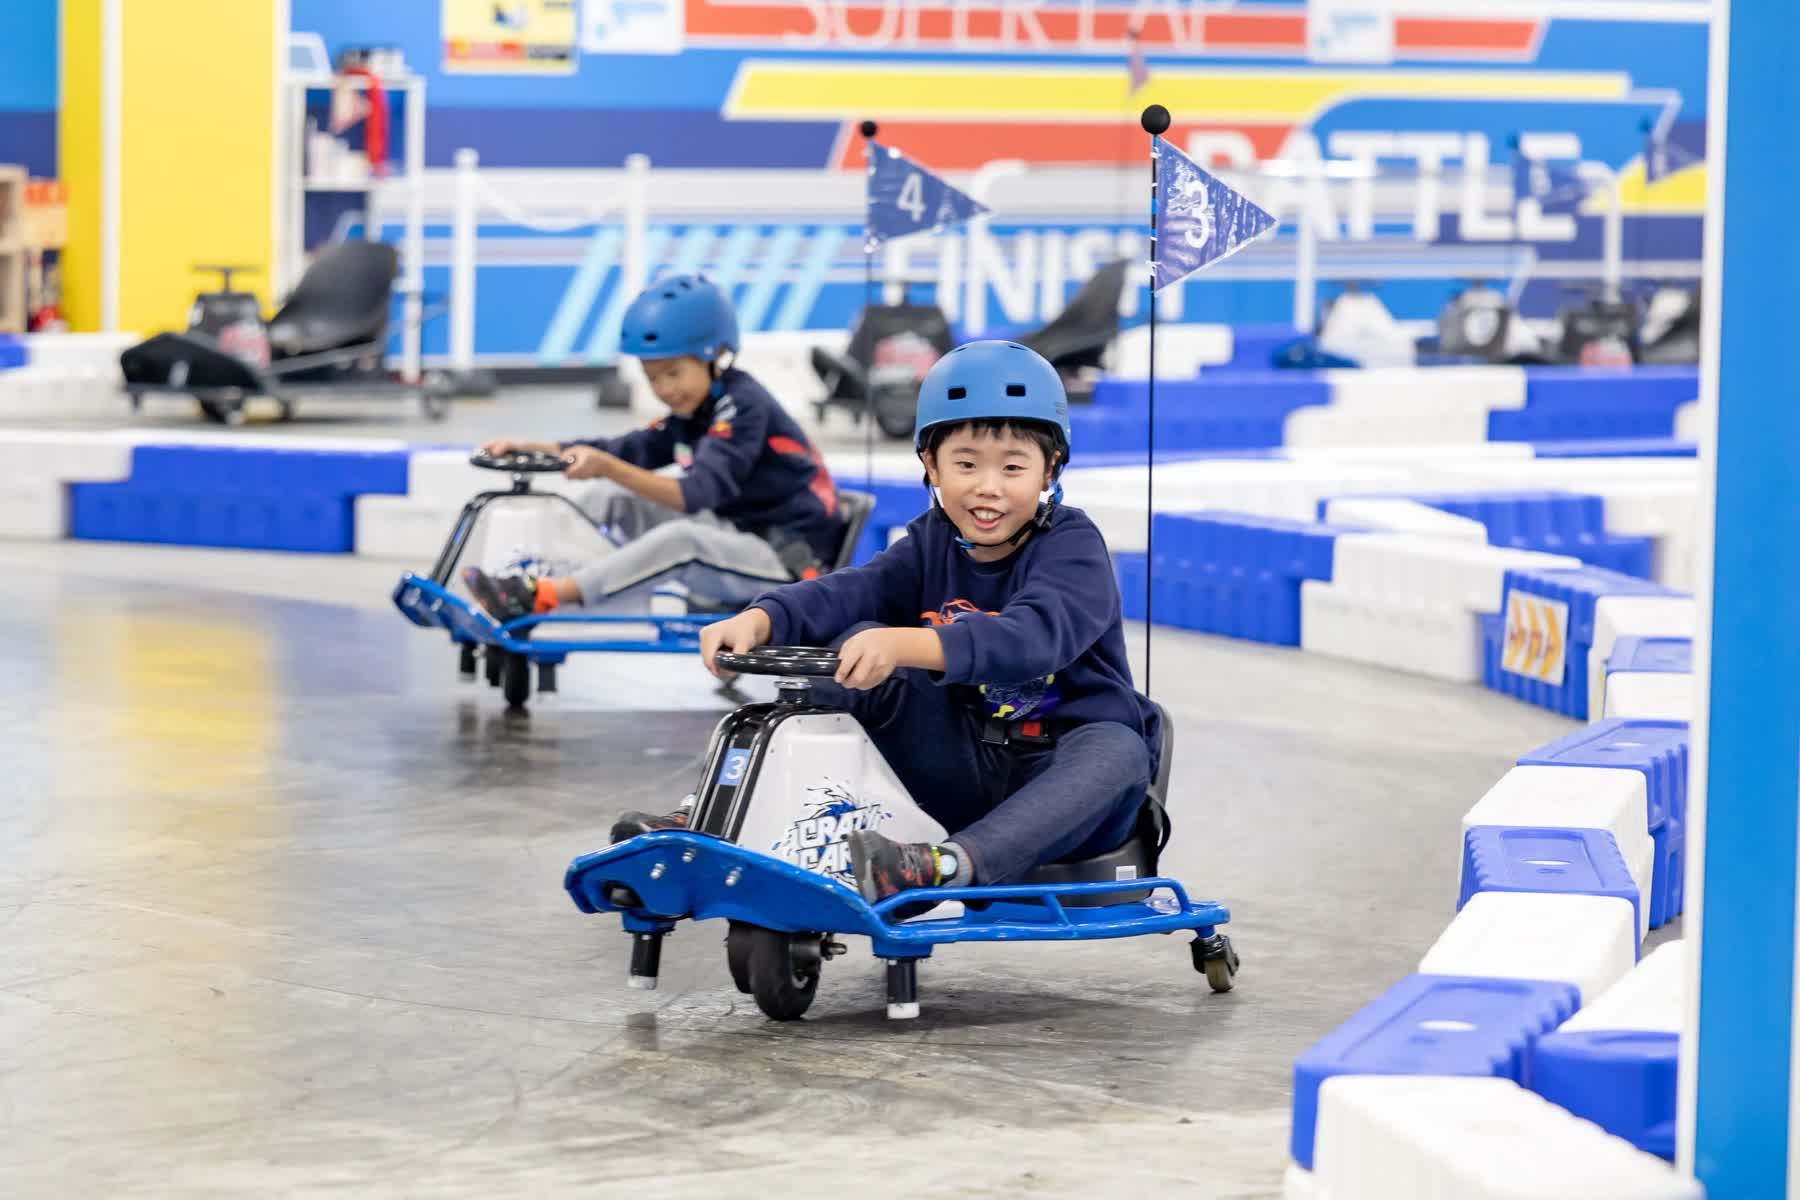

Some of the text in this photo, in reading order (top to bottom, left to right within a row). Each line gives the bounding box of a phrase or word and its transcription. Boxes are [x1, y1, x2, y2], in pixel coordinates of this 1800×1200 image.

[896, 171, 927, 223] 4
[1184, 179, 1211, 249] 3
[725, 754, 748, 780] 3
